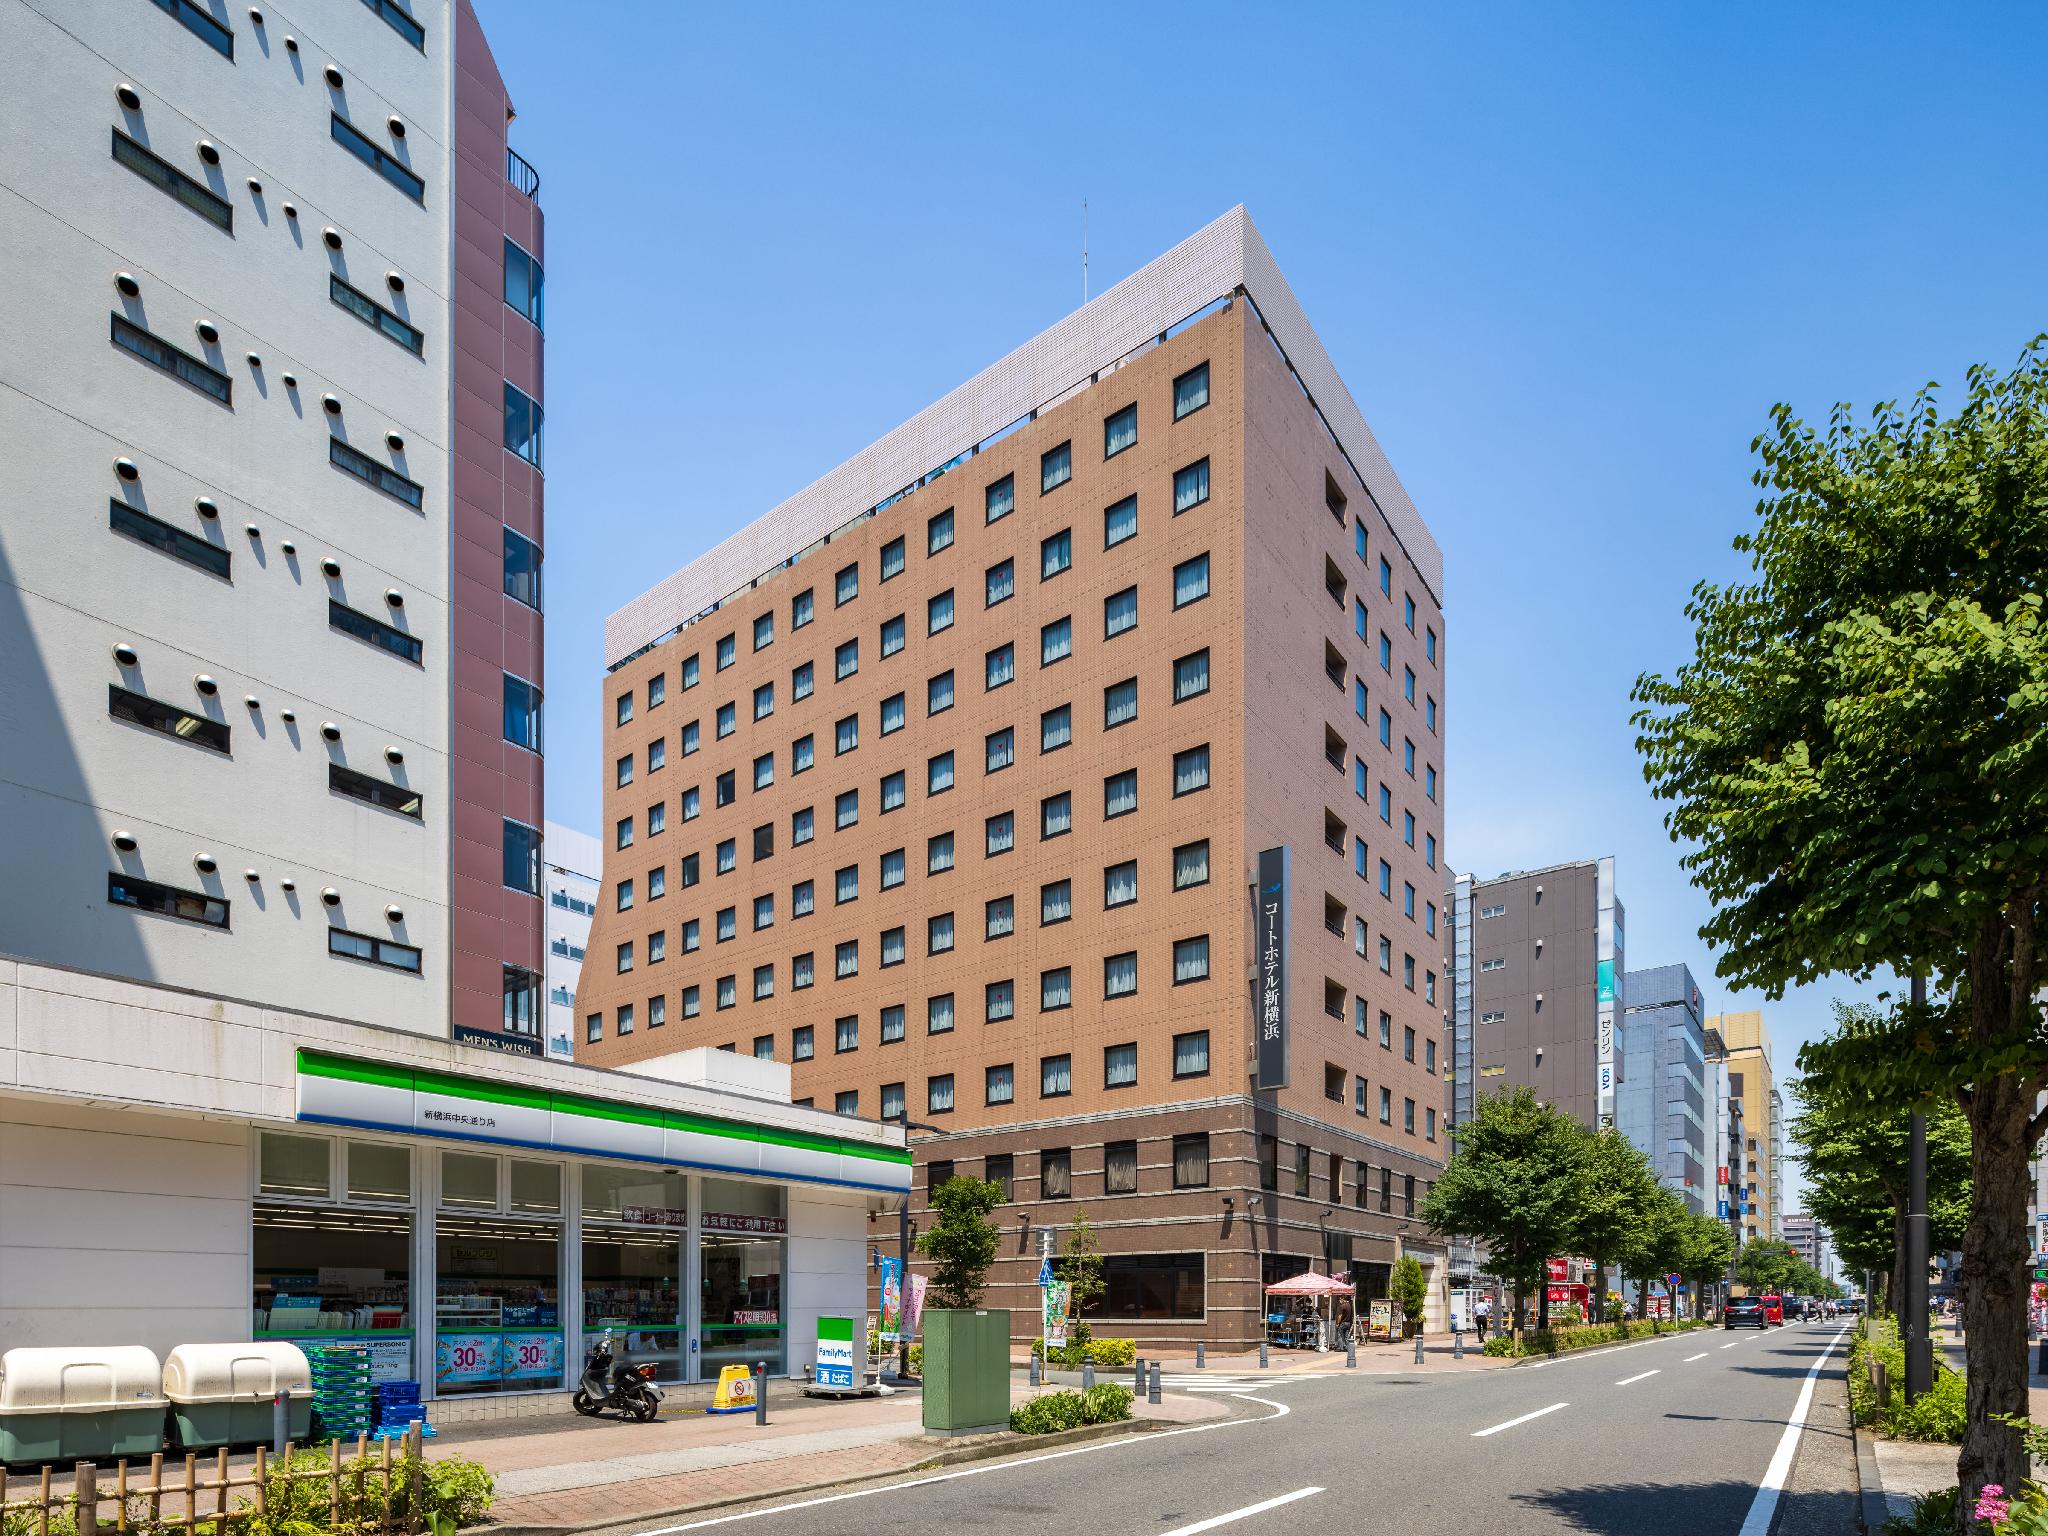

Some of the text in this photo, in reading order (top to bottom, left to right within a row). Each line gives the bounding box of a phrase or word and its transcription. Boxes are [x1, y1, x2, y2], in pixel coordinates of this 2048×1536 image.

[1263, 902, 1280, 1041] コートホテル新横浜
[463, 1034, 531, 1055] MEN'S WISH
[1602, 1020, 1611, 1055] ゼンリン
[424, 1109, 496, 1128] 新横浜中央通り店
[818, 1347, 852, 1359] FamilyMart
[820, 1371, 850, 1385] 酒 たばこ
